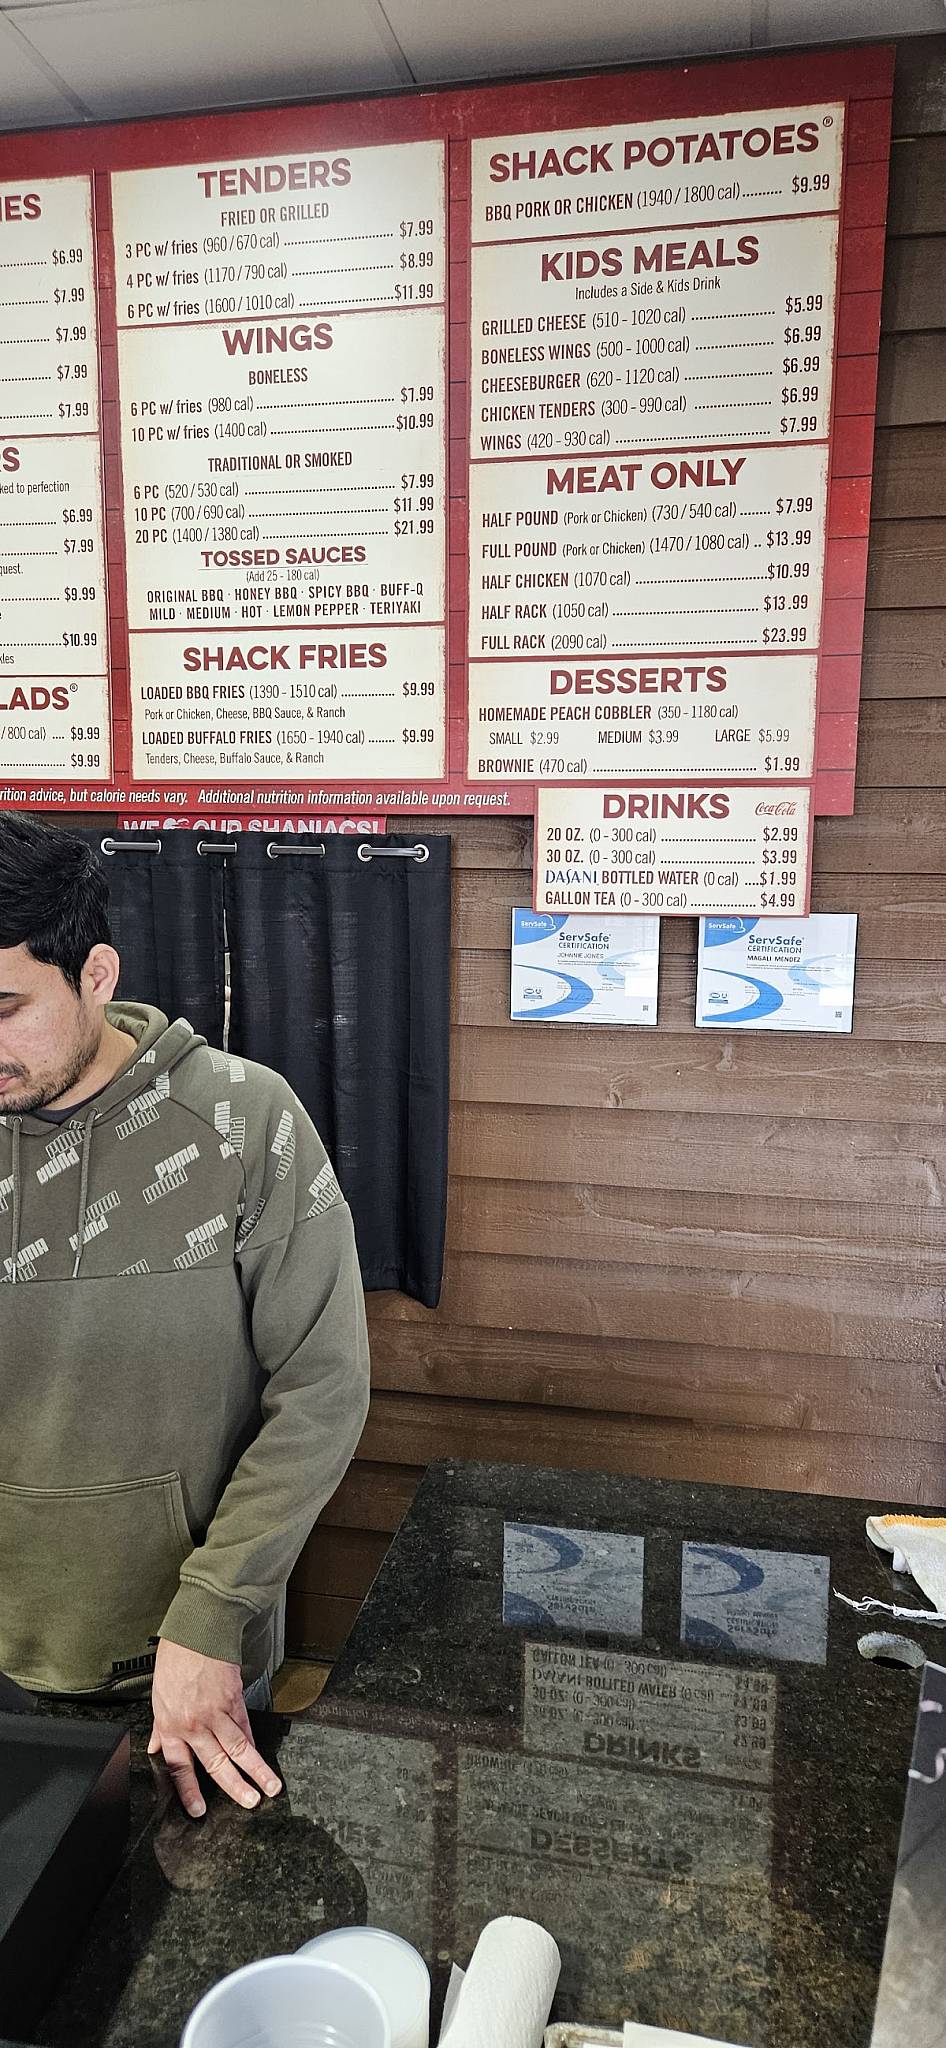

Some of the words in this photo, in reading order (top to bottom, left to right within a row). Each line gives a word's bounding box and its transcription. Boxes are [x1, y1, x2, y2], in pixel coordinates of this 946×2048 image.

[489, 143, 613, 182] SHACK
[197, 158, 351, 198] TENDERS
[486, 204, 512, 221] BBQ
[516, 200, 550, 219] PORK
[555, 199, 571, 215] OR
[577, 193, 633, 213] CHICKEN
[792, 174, 829, 194] $9.99
[221, 210, 255, 227] FRIED
[260, 208, 275, 223] OR
[280, 203, 329, 221] GRILLED
[125, 244, 132, 259] 3
[136, 242, 151, 258] PC
[171, 240, 198, 255] fries
[400, 220, 433, 239] $7.99
[52, 248, 82, 266] $6.99
[541, 248, 622, 282] KIDS
[634, 236, 759, 274] MEALS
[54, 287, 84, 304] $7.99
[576, 285, 618, 300] Includes
[621, 286, 627, 297] a
[631, 282, 653, 295] Side
[656, 280, 664, 294] &
[668, 278, 689, 292] Kids
[693, 276, 720, 291] Drink
[482, 318, 533, 336] GRILLED
[538, 314, 586, 332] CHEESE
[785, 295, 822, 315] $5.99
[222, 323, 333, 356] WINGS
[482, 346, 544, 365] BONELESS
[548, 343, 591, 360] WINGS
[784, 326, 821, 345] $6.99
[249, 367, 308, 385] BONELESS
[482, 373, 580, 393] CHEESEBURGER
[783, 356, 819, 376] $6.99
[132, 427, 144, 442] 10
[149, 426, 163, 441] PC
[183, 425, 209, 439] fries
[396, 413, 433, 432] $10.99
[208, 455, 282, 472] TRADITIONAL
[285, 454, 301, 468] OR
[305, 452, 352, 467] SMOKED
[547, 464, 642, 495] MEAT
[651, 457, 747, 489] ONLY
[16, 483, 25, 494] to
[27, 480, 69, 495] perfection
[62, 509, 92, 523] $6.99
[483, 512, 512, 528] HALF
[516, 510, 558, 526] POUND
[564, 511, 588, 526] (Pork
[591, 513, 602, 523] or
[604, 508, 647, 523] Chicken)
[776, 497, 812, 515] $7.99
[201, 549, 280, 567] TOSSED
[285, 545, 366, 564] SAUCES
[482, 575, 511, 589] HALF
[516, 572, 568, 588] CHICKEN
[768, 563, 809, 580] $10.99
[64, 586, 95, 602] $9.99
[147, 590, 198, 603] ORIGINAL
[202, 589, 224, 602] BBQ
[235, 588, 270, 600] HONEY
[275, 587, 297, 599] BBQ
[309, 585, 342, 598] SPICY
[346, 584, 369, 597] BBQ
[381, 583, 423, 596] BUFF-Q
[150, 608, 175, 620] MILD
[187, 607, 230, 619] MEDIUM
[242, 605, 262, 618] HOT
[274, 604, 310, 617] LEMON
[315, 603, 358, 616] PEPPER
[370, 601, 420, 614] TERIYAKI
[62, 632, 97, 646] $10.99
[183, 645, 291, 671] SHACK
[300, 643, 387, 669] FRIES
[550, 666, 727, 695] DESSERTS
[141, 686, 182, 700] LOADED
[187, 686, 209, 700] BBQ
[213, 685, 245, 699] FRIES
[403, 682, 434, 697] $9.99
[145, 709, 164, 720] Pork
[166, 711, 174, 720] or
[177, 708, 213, 720] Chicken,
[216, 708, 250, 720] Cheese,
[253, 707, 272, 719] BBQ
[274, 707, 304, 720] Sauce,
[307, 707, 314, 718] &
[317, 706, 345, 718] Ranch
[479, 707, 546, 721] HOMEMADE
[550, 706, 590, 720] PEACH
[595, 705, 651, 720] COBBLER
[142, 731, 183, 744] LOADED
[188, 731, 236, 744] BUFFALO
[240, 731, 272, 744] FRIES
[402, 728, 434, 744] $9.99
[489, 732, 523, 745] SMALL
[530, 731, 559, 745] $2.99
[598, 731, 642, 743] MEDIUM
[649, 729, 679, 744] $3.99
[715, 729, 751, 742] LARGE
[758, 728, 789, 743] $5.99
[71, 753, 100, 767] $9.99
[478, 759, 534, 773] BROWNIE
[764, 756, 800, 772] $1.99
[29, 788, 66, 804] advice,
[70, 788, 88, 802] but
[90, 788, 126, 802] calorie
[129, 789, 160, 802] needs
[164, 792, 188, 805] vary.
[198, 789, 254, 803] Additional
[257, 790, 304, 804] nutrition
[307, 790, 372, 804] information
[376, 790, 429, 805] available
[432, 794, 461, 808] upon
[463, 792, 510, 808] request.
[603, 793, 730, 819] DRINKS
[547, 828, 561, 841] 20
[566, 827, 584, 841] OZ.
[763, 826, 798, 843] $2.99
[546, 869, 597, 884] DASANI
[602, 870, 654, 884] BOTTLED
[658, 871, 698, 885] WATER
[760, 871, 796, 886] $1.99
[546, 891, 590, 905] GALLON
[594, 892, 615, 905] TEA
[761, 892, 795, 908] $4.99
[558, 932, 610, 943] ServSafe
[558, 942, 609, 950] CERTIFICATION
[748, 934, 803, 946] ServSafe
[747, 945, 802, 954] CERTIFICATION
